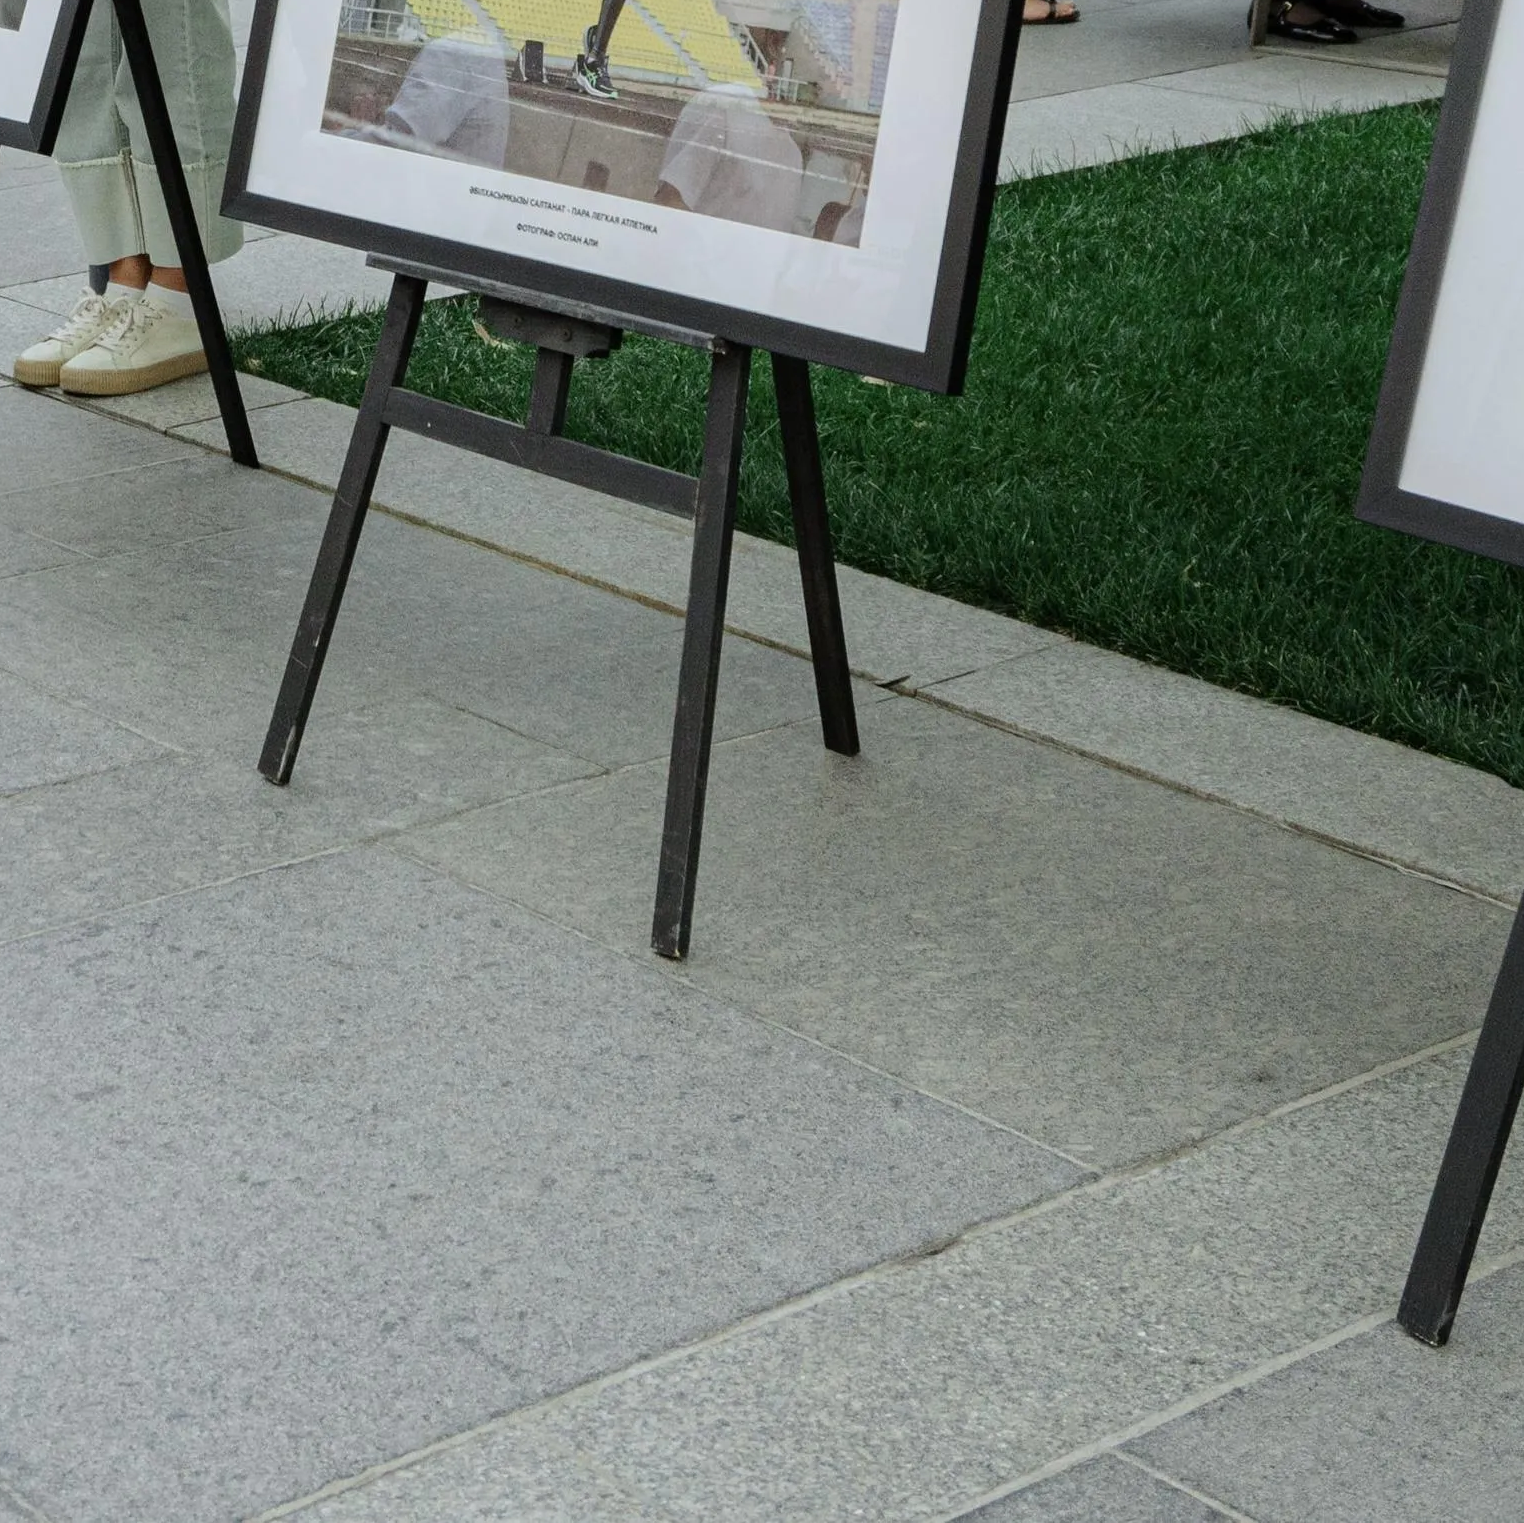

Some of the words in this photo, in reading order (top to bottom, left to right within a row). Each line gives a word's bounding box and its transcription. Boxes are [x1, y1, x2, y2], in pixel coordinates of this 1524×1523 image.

[529, 199, 566, 214] САЛТАНАТ
[571, 206, 591, 220] ПАРА
[591, 210, 620, 226] ЛЕГКАЯ
[620, 217, 658, 235] АТЛЕТИКА
[557, 231, 582, 245] ОСПАН
[582, 237, 599, 248] АЛИ
